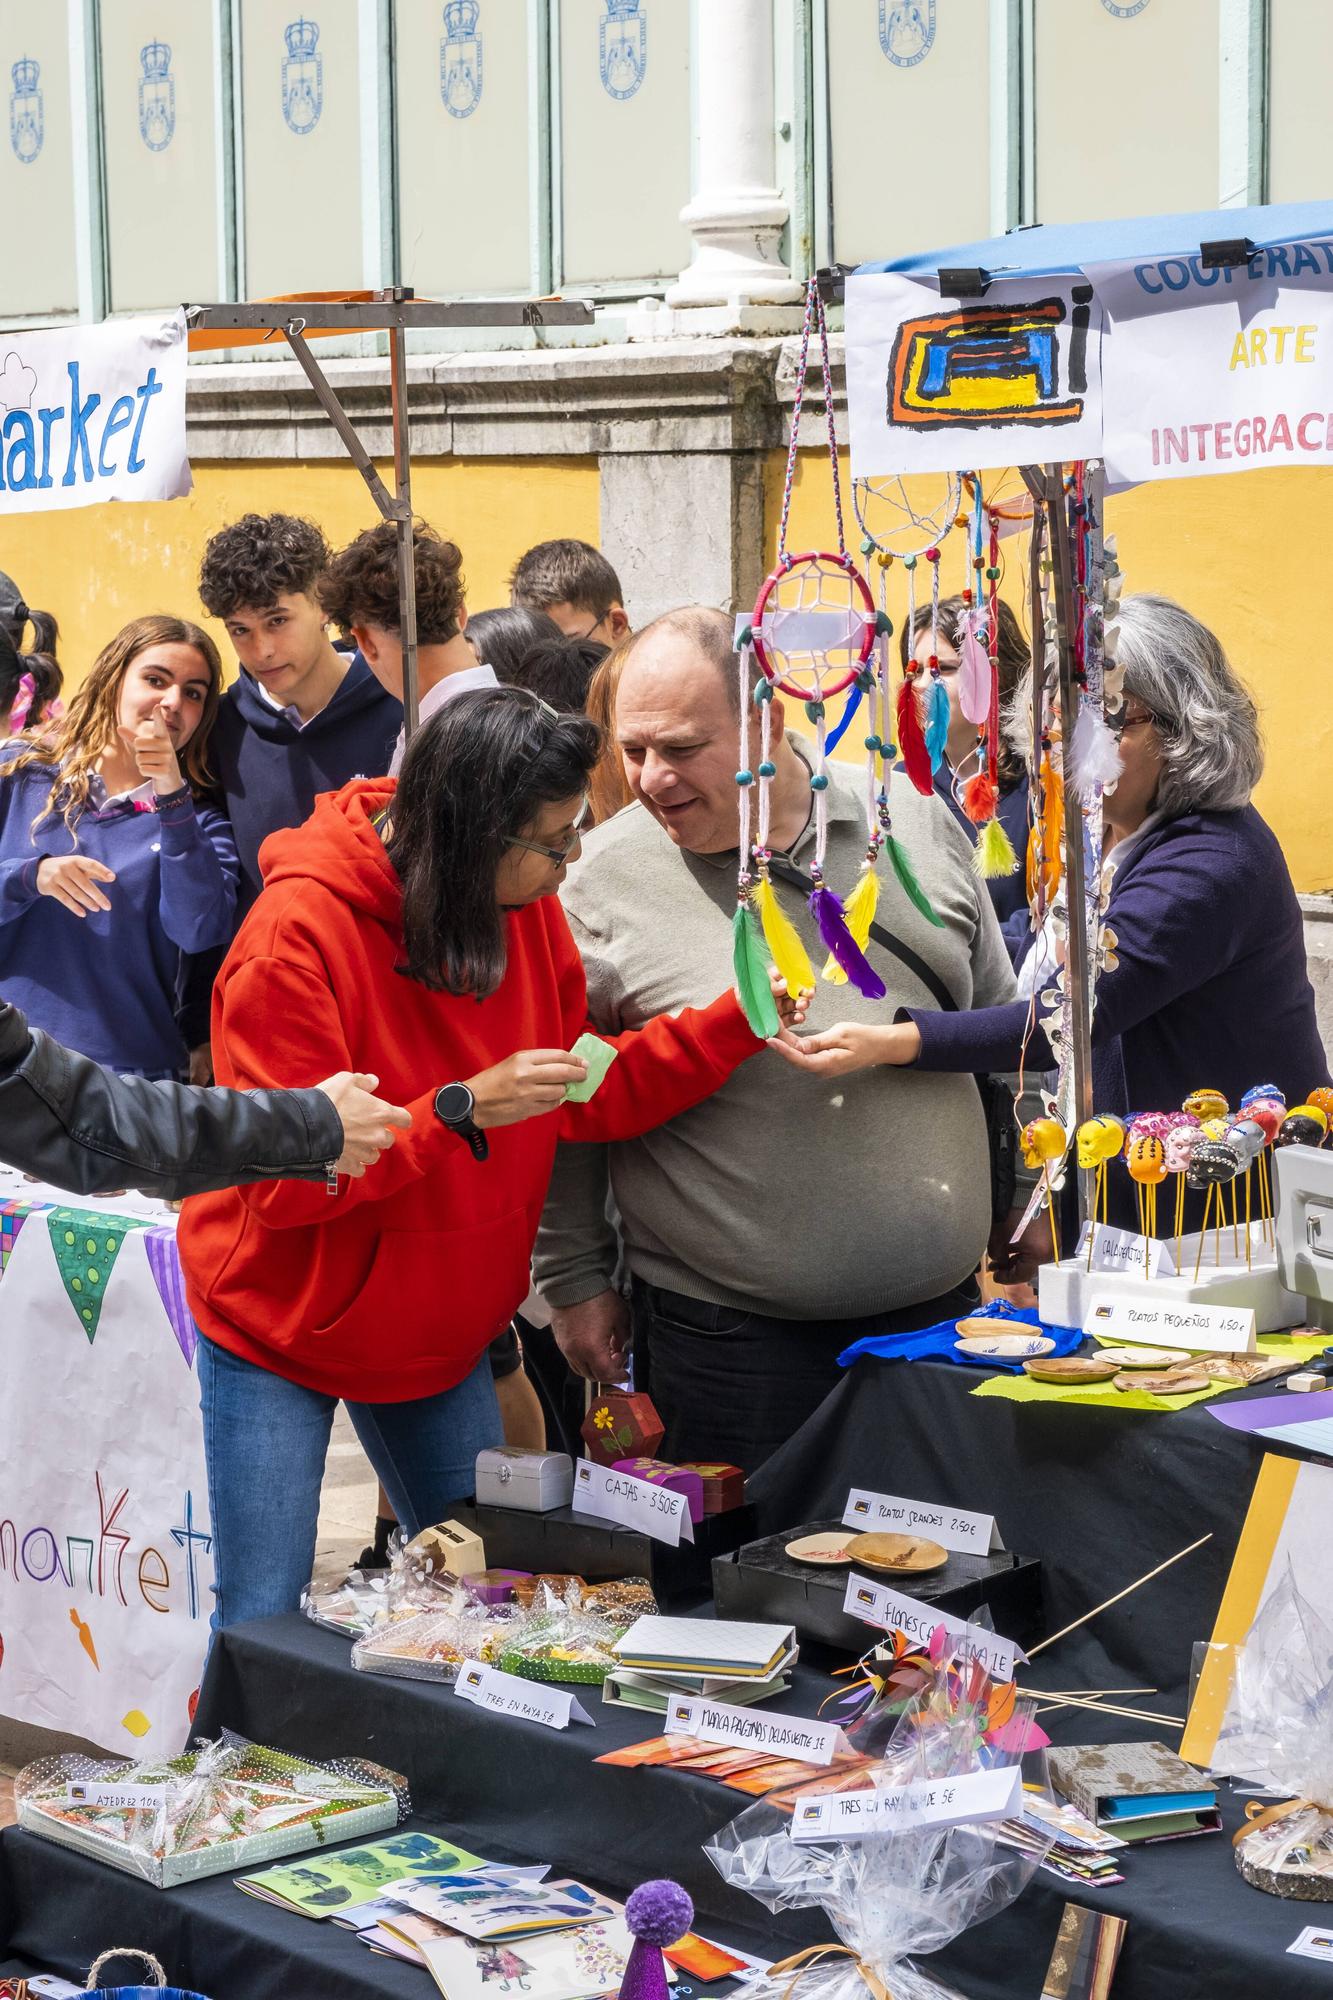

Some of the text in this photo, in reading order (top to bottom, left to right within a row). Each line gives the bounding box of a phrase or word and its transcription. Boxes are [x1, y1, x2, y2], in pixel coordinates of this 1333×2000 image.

[1228, 324, 1319, 371] ARTE
[0, 361, 163, 492] arket
[1128, 1309, 1158, 1322] PLATOS
[605, 1478, 638, 1502] CAJAS
[878, 1504, 905, 1518] PLATOS
[486, 1692, 505, 1707] TRES
[507, 1699, 519, 1711] EN
[521, 1702, 541, 1718] RAYA
[96, 1794, 136, 1807] AJEDREZ
[839, 1799, 861, 1815] TRES
